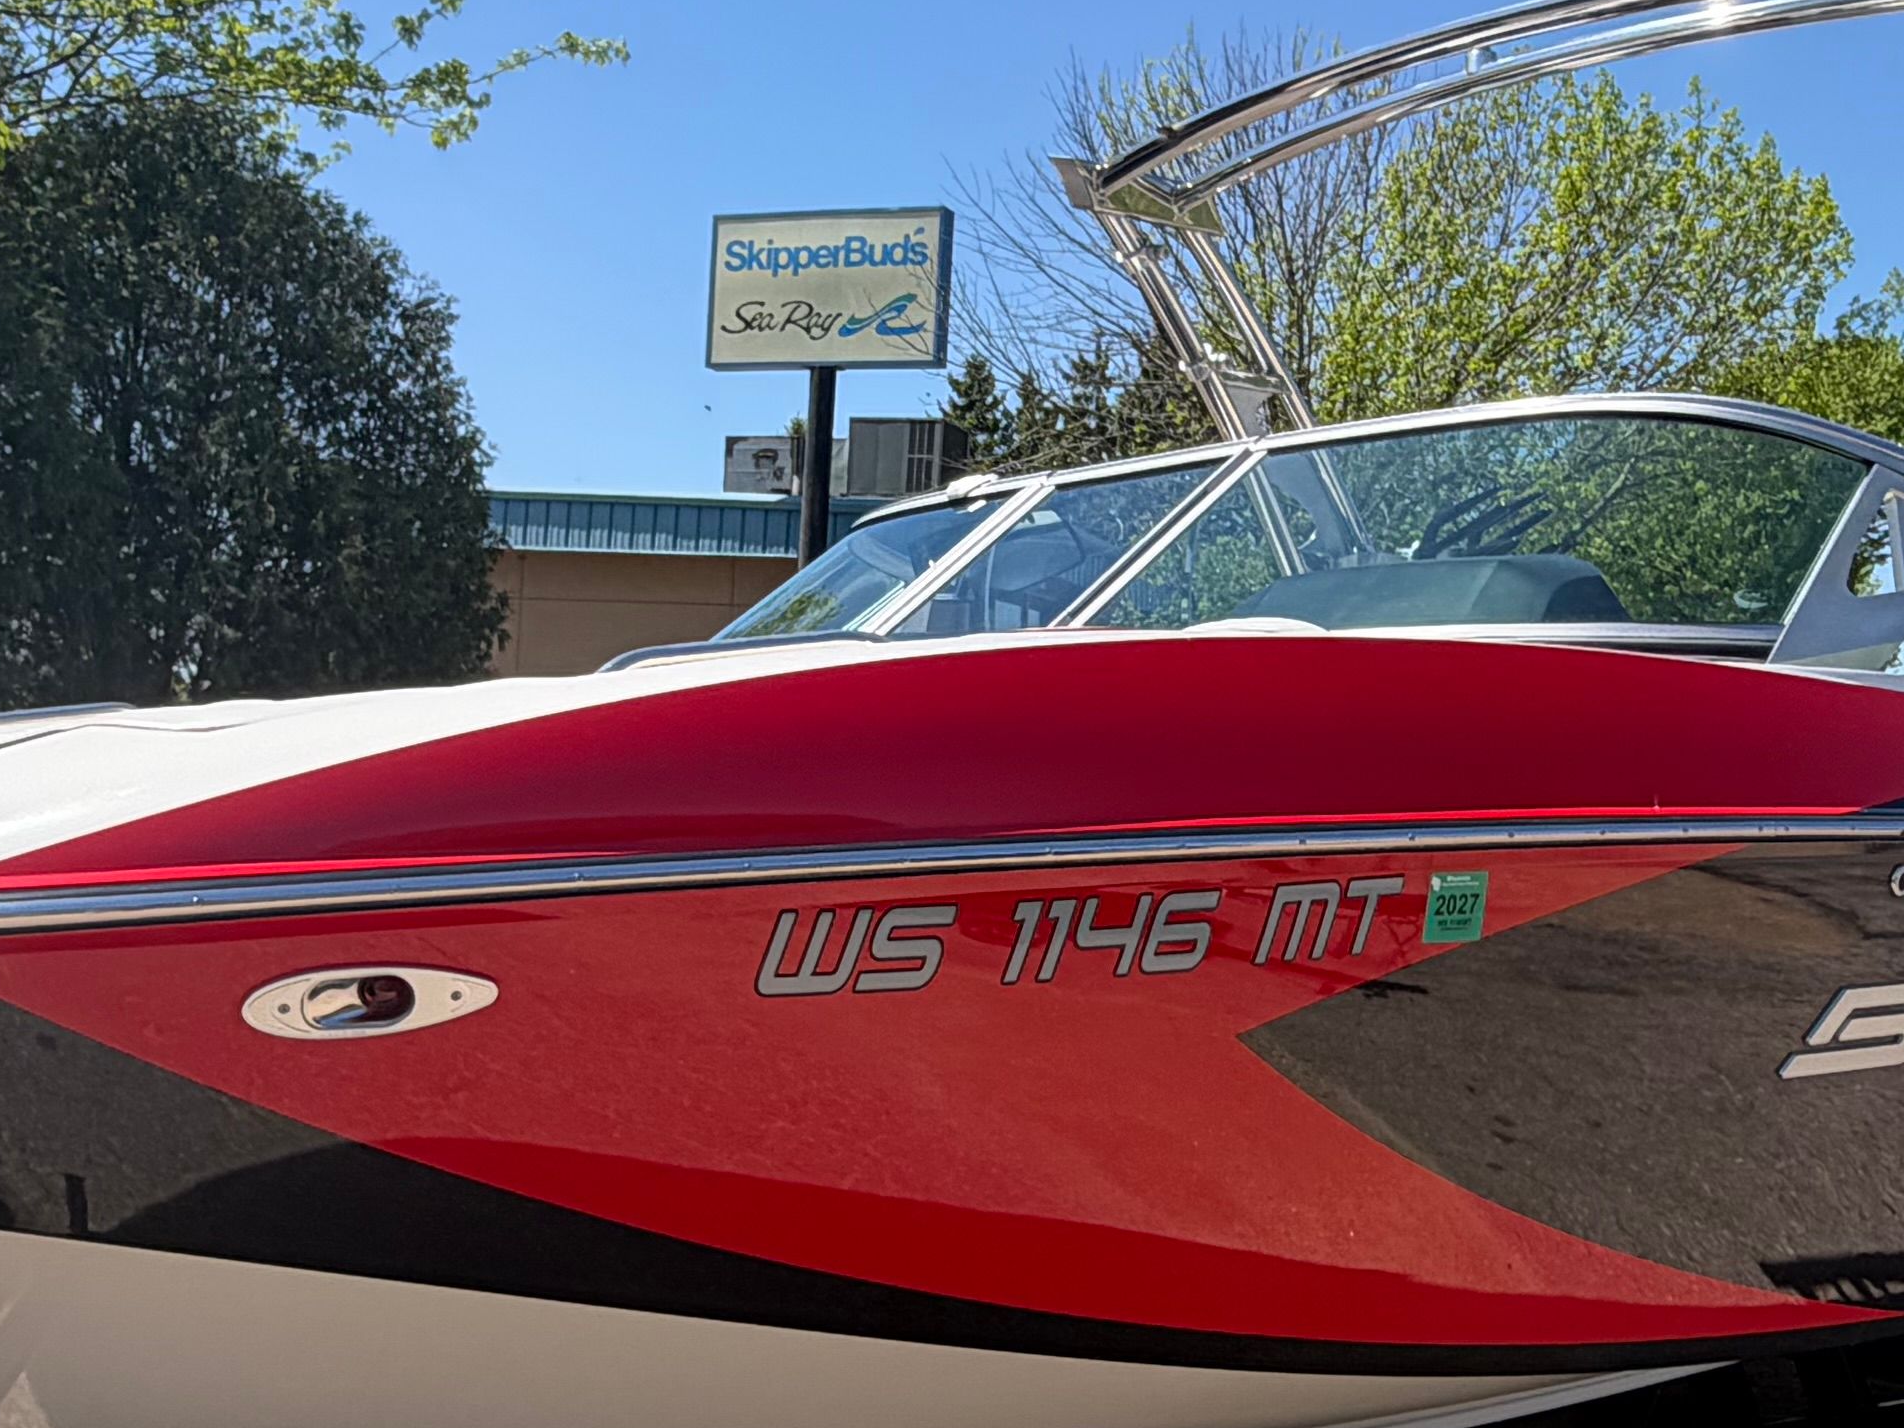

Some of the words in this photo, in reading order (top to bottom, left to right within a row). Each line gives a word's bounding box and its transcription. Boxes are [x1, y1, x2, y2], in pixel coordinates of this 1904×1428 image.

[724, 227, 928, 277] SkipperBud's
[720, 301, 780, 334] Sea
[780, 301, 842, 340] Ray
[1434, 893, 1480, 917] 2027
[754, 903, 958, 997] WS
[1000, 890, 1222, 985] 1146
[1252, 873, 1406, 966] MT
